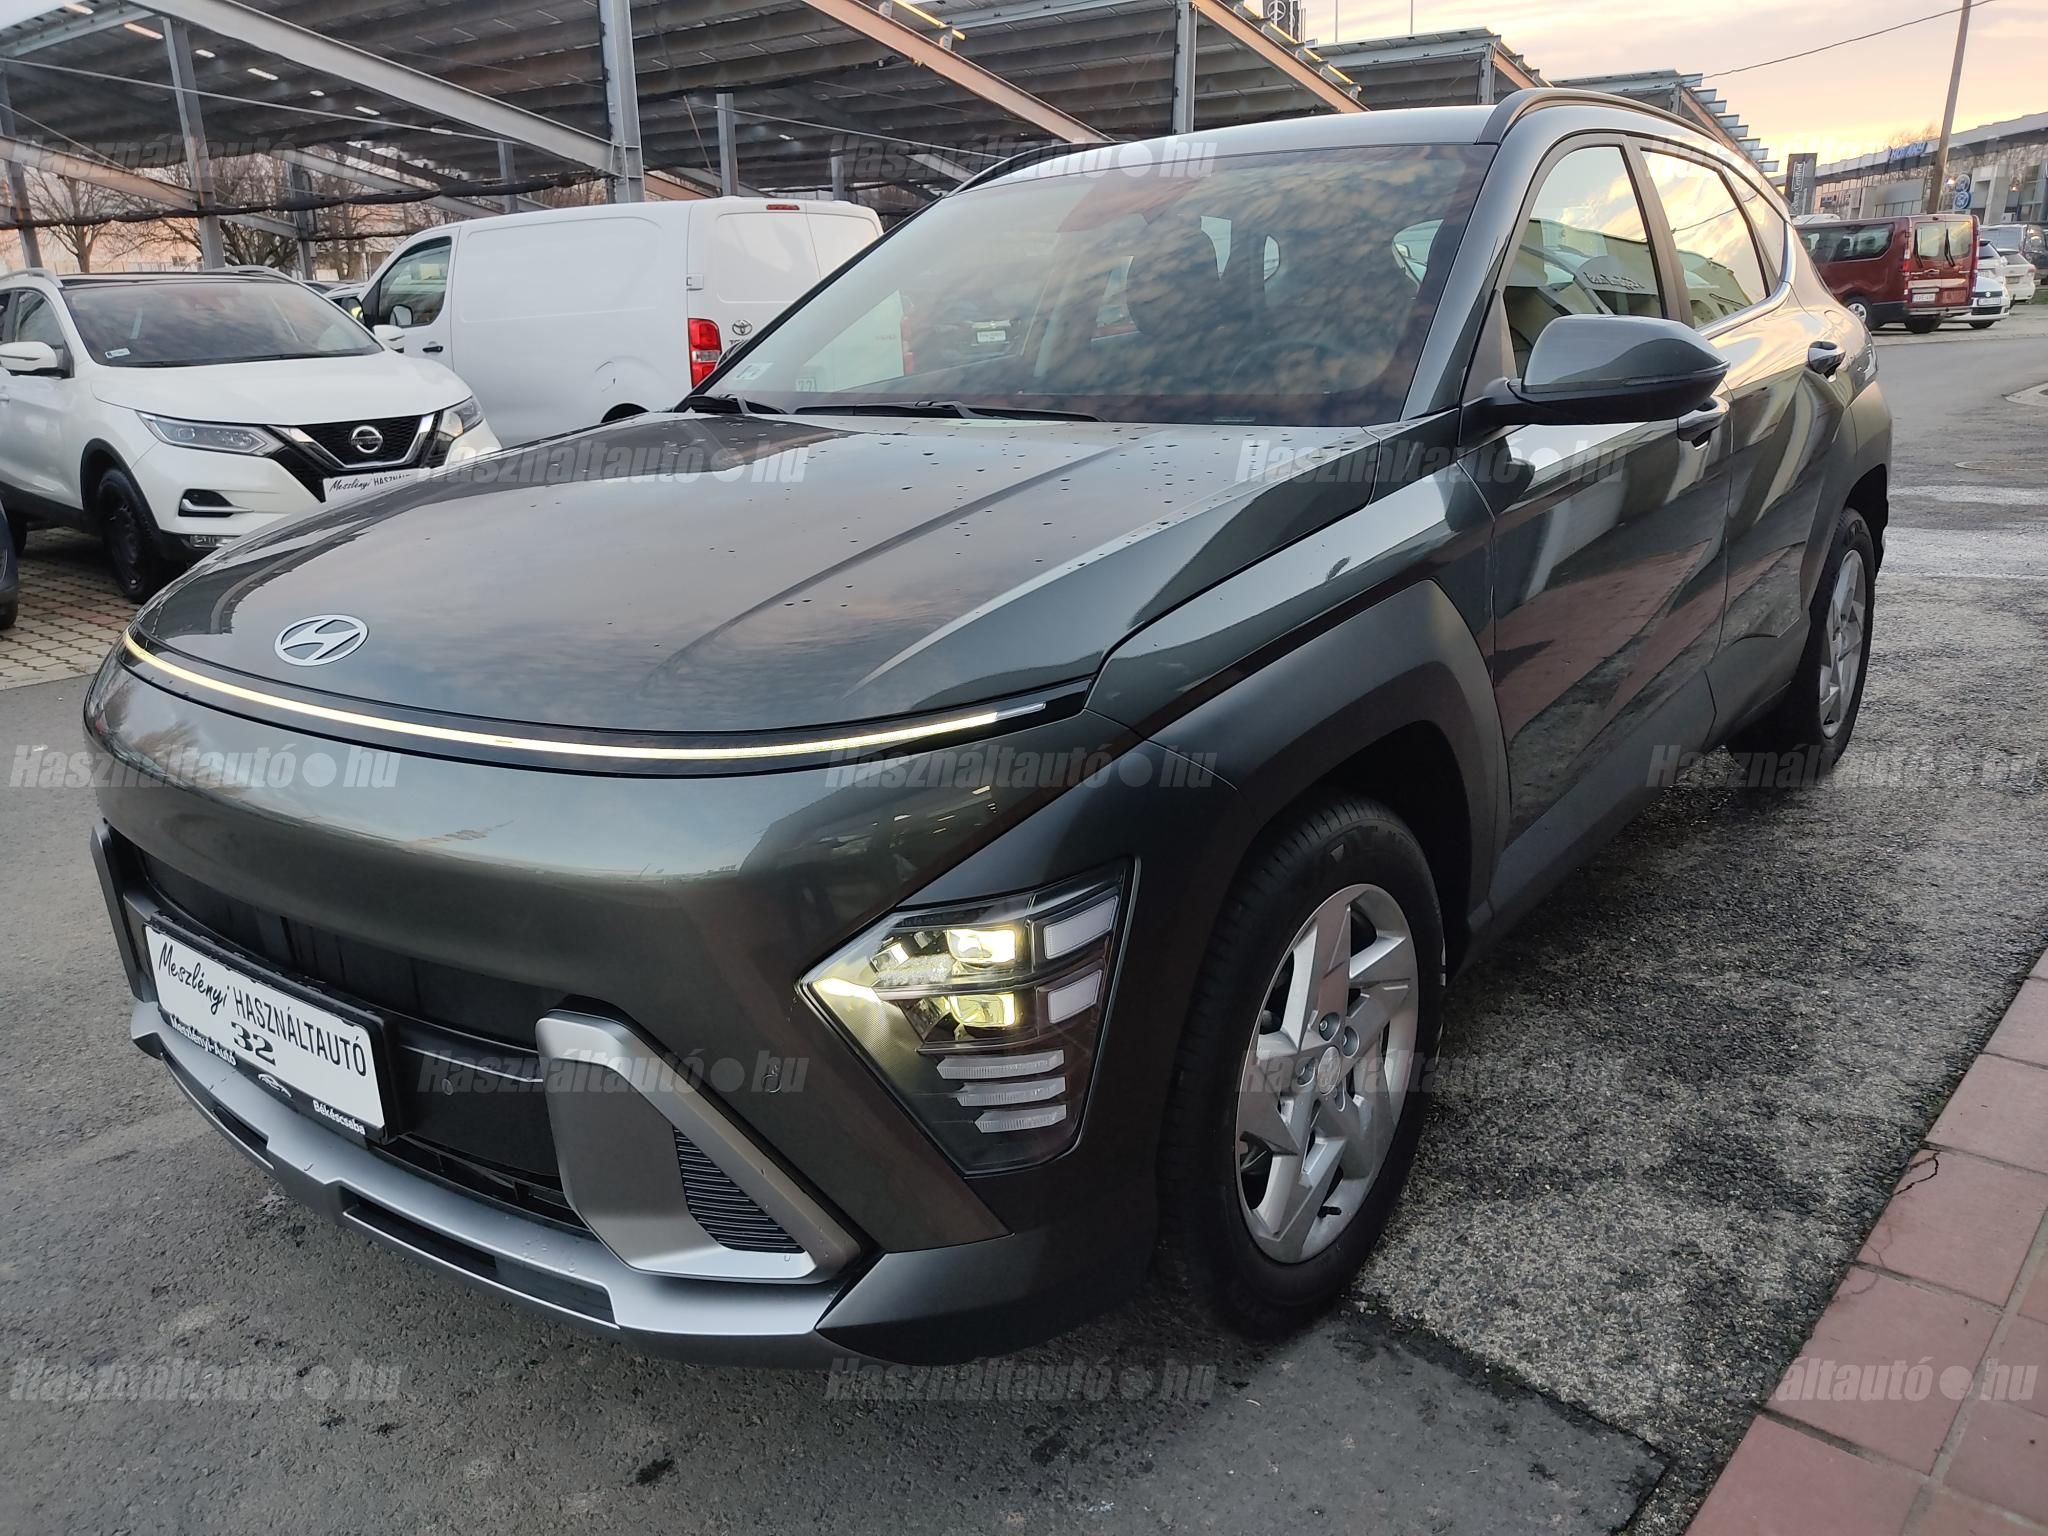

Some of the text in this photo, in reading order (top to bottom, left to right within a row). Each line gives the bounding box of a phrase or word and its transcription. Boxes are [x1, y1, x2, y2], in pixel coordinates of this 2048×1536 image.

[158, 941, 367, 1077] Meszlényi HASZNÁLTAUTÓ
[230, 1021, 277, 1067] 32
[313, 1099, 367, 1136] Békéscsaba
